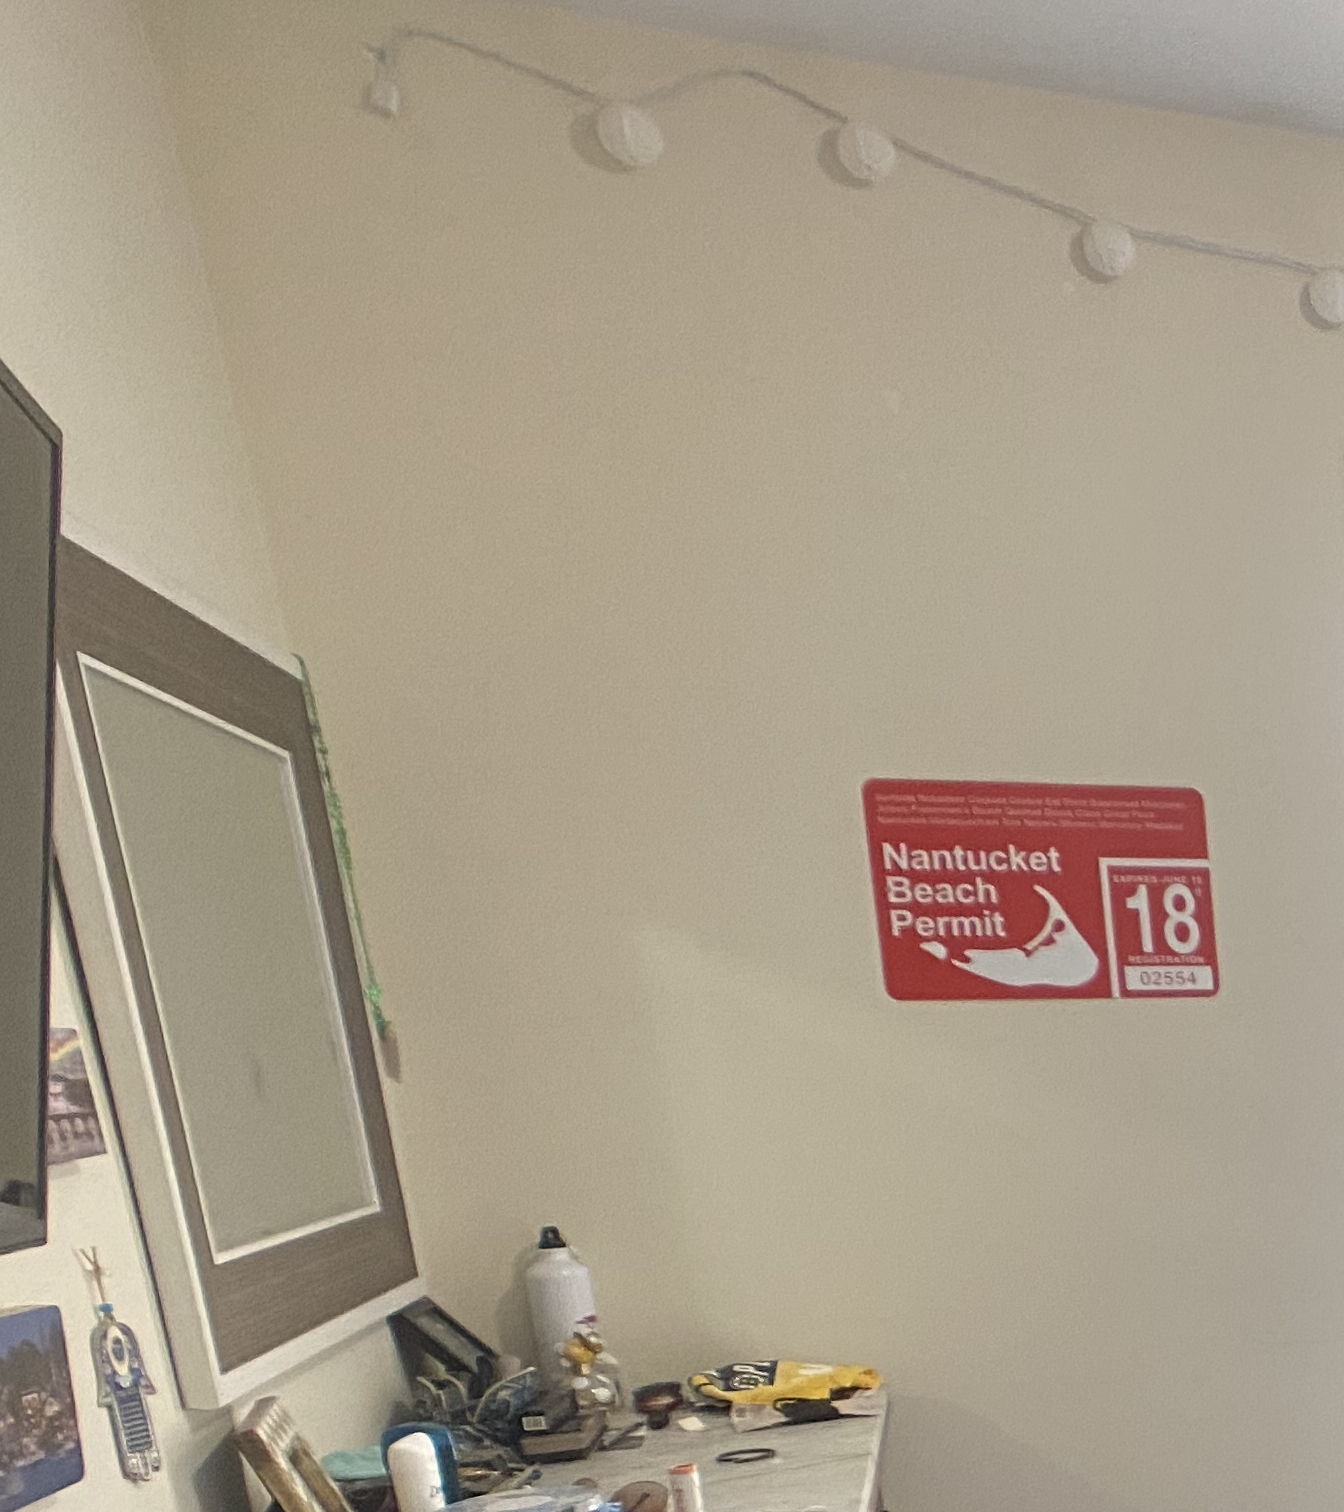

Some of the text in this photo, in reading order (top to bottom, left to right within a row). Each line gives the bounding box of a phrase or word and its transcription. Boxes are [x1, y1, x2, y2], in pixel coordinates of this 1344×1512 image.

[881, 842, 1062, 873] Nantucket
[885, 875, 999, 904] Beach
[890, 909, 1006, 937] Permit
[1125, 883, 1200, 954] 18
[1140, 970, 1197, 986] 02554
